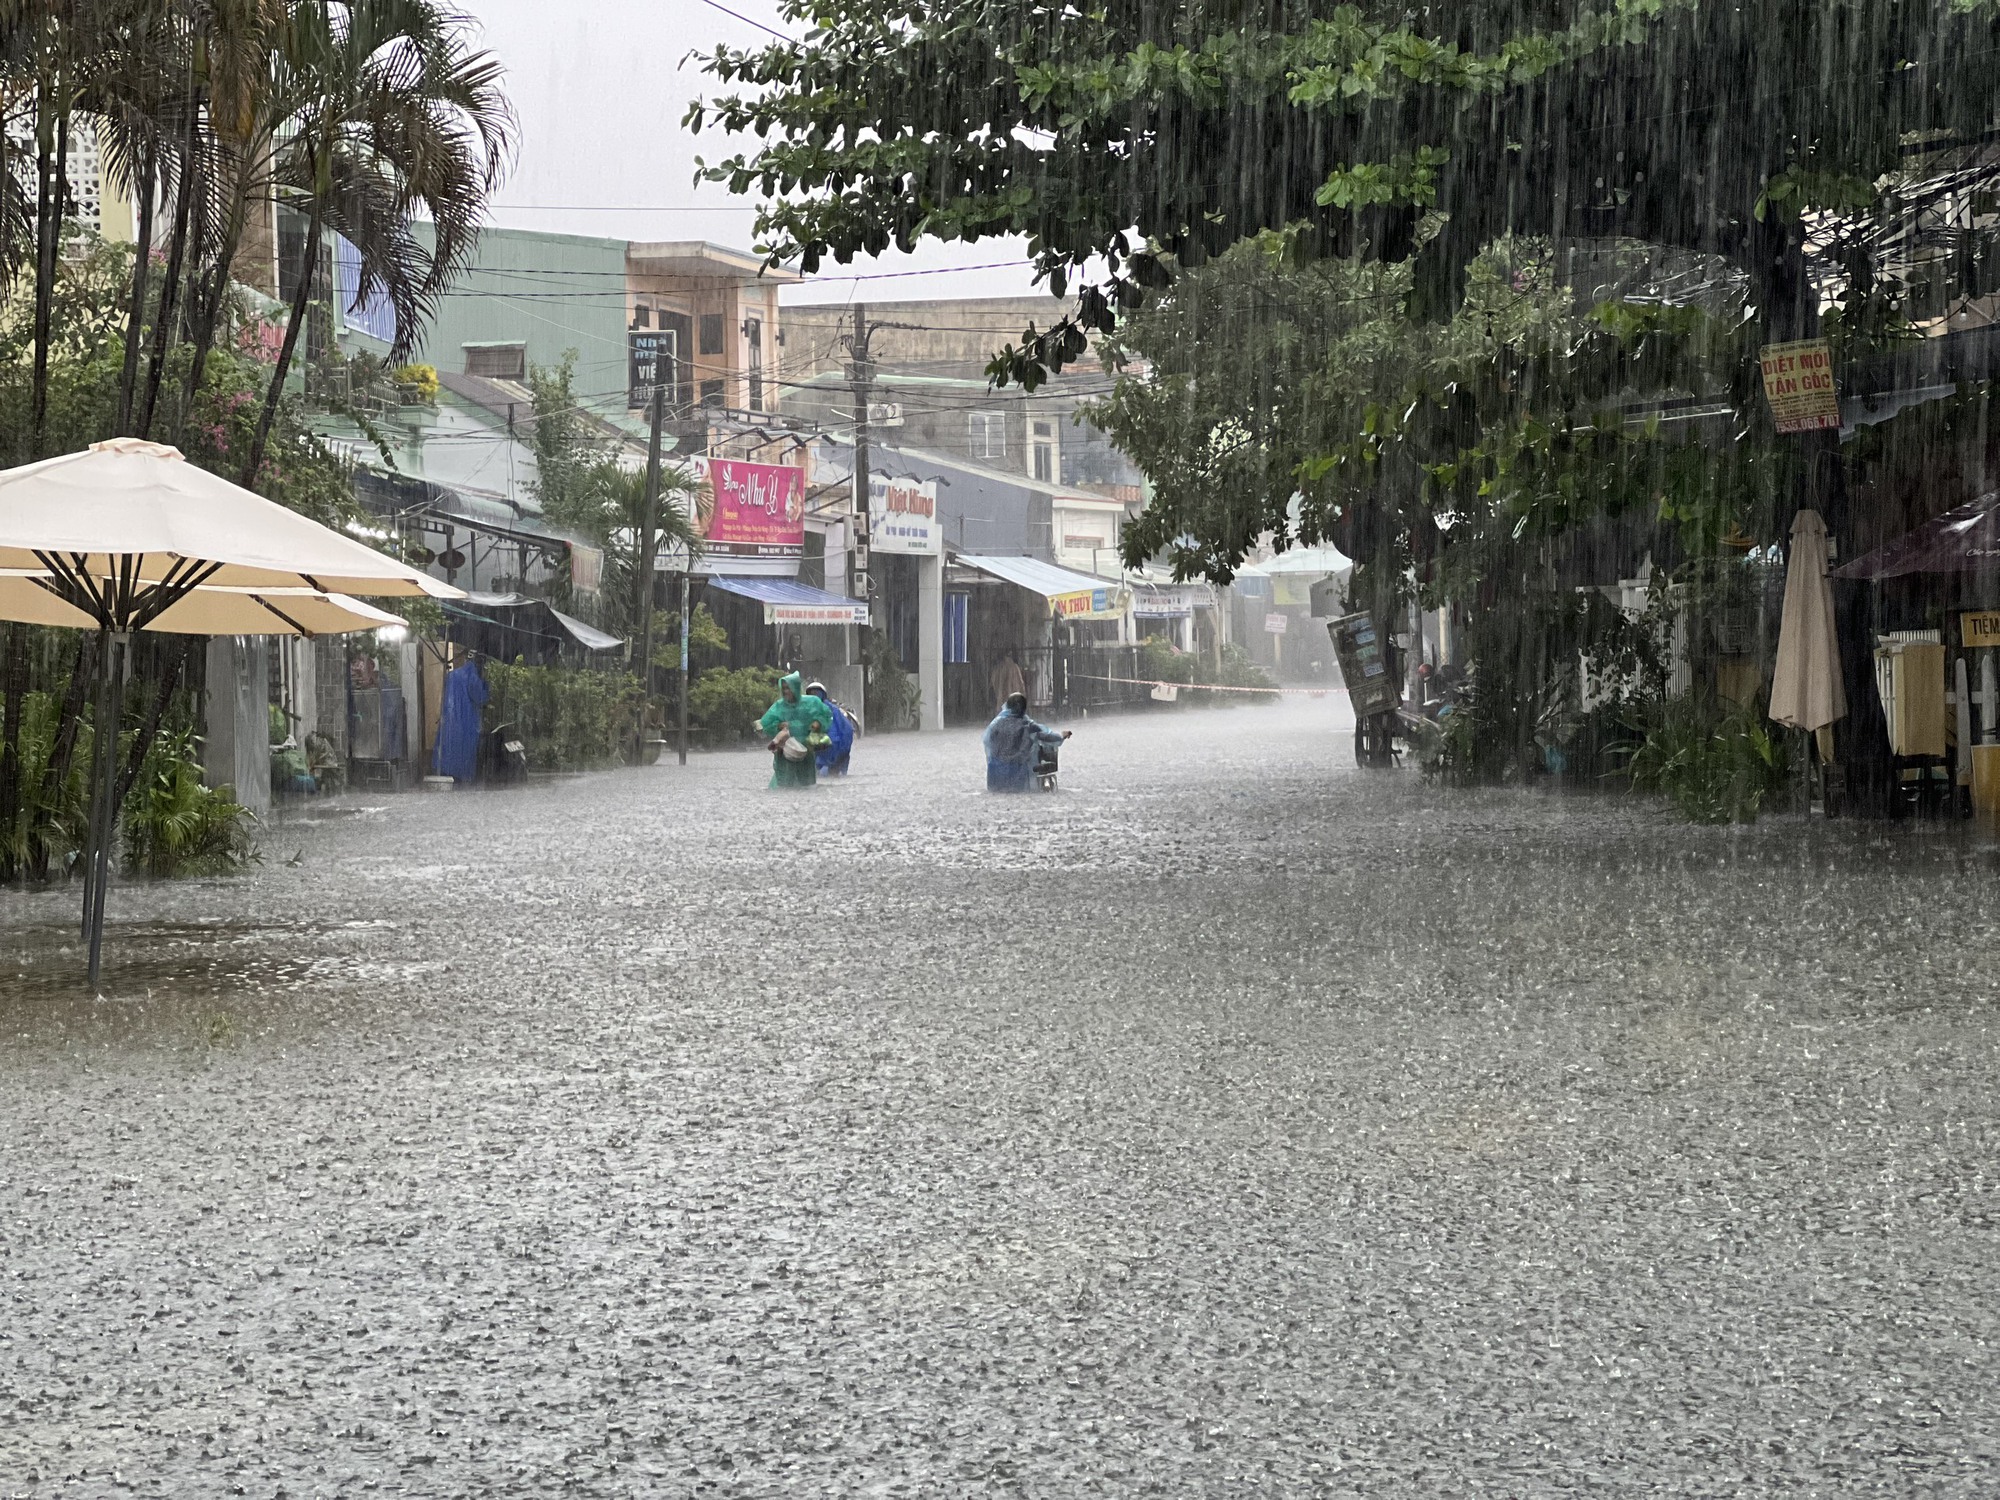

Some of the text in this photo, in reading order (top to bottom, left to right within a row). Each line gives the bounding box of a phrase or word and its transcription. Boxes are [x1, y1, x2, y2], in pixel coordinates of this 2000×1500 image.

[637, 362, 657, 382] VIỆ
[1762, 355, 1795, 376] DIỆT
[1766, 377, 1798, 398] TẬN
[886, 485, 908, 518] Việt
